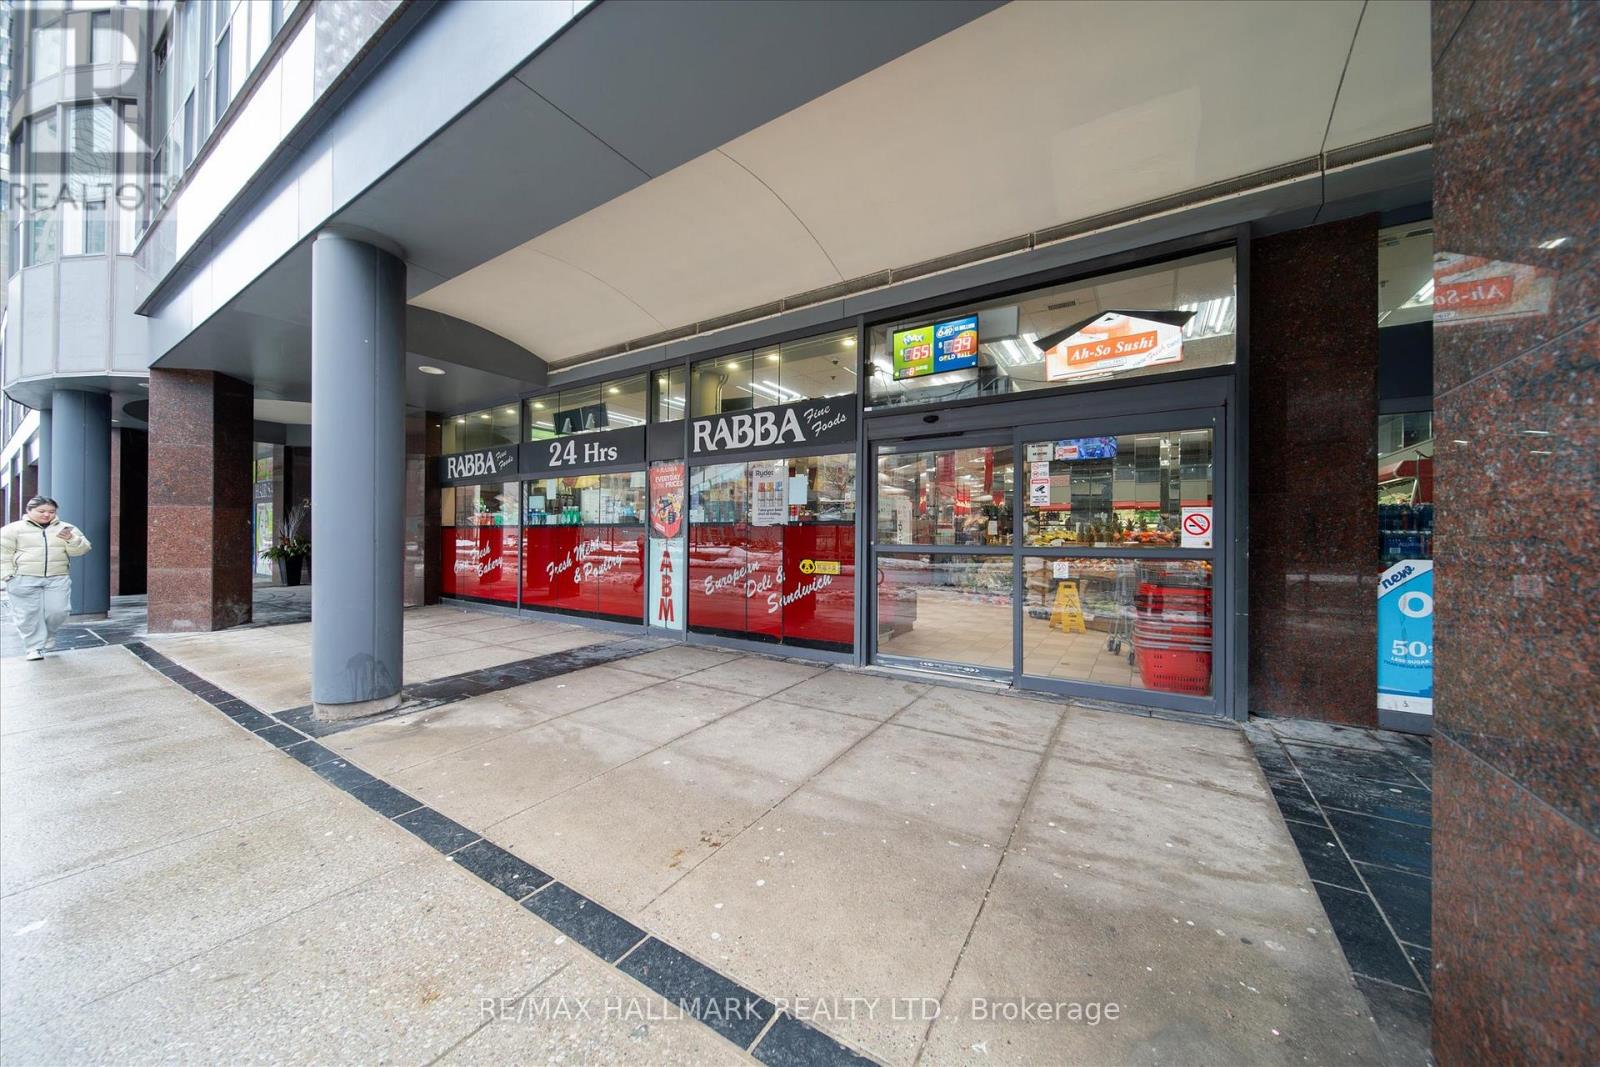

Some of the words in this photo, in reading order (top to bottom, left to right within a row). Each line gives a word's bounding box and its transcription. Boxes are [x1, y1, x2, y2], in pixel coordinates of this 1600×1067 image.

[1071, 344, 1111, 361] Ah-So
[1115, 336, 1154, 354] Sushi
[693, 408, 806, 452] RABBA
[803, 405, 831, 424] Fine
[811, 412, 848, 437] Foods
[447, 451, 497, 479] RABBA
[548, 439, 578, 467] 24
[583, 442, 618, 463] Hrs
[546, 551, 573, 582] Fresh
[574, 567, 582, 584] &
[658, 551, 674, 622] ABM
[744, 574, 773, 598] Deli
[767, 574, 832, 614] Sandwich
